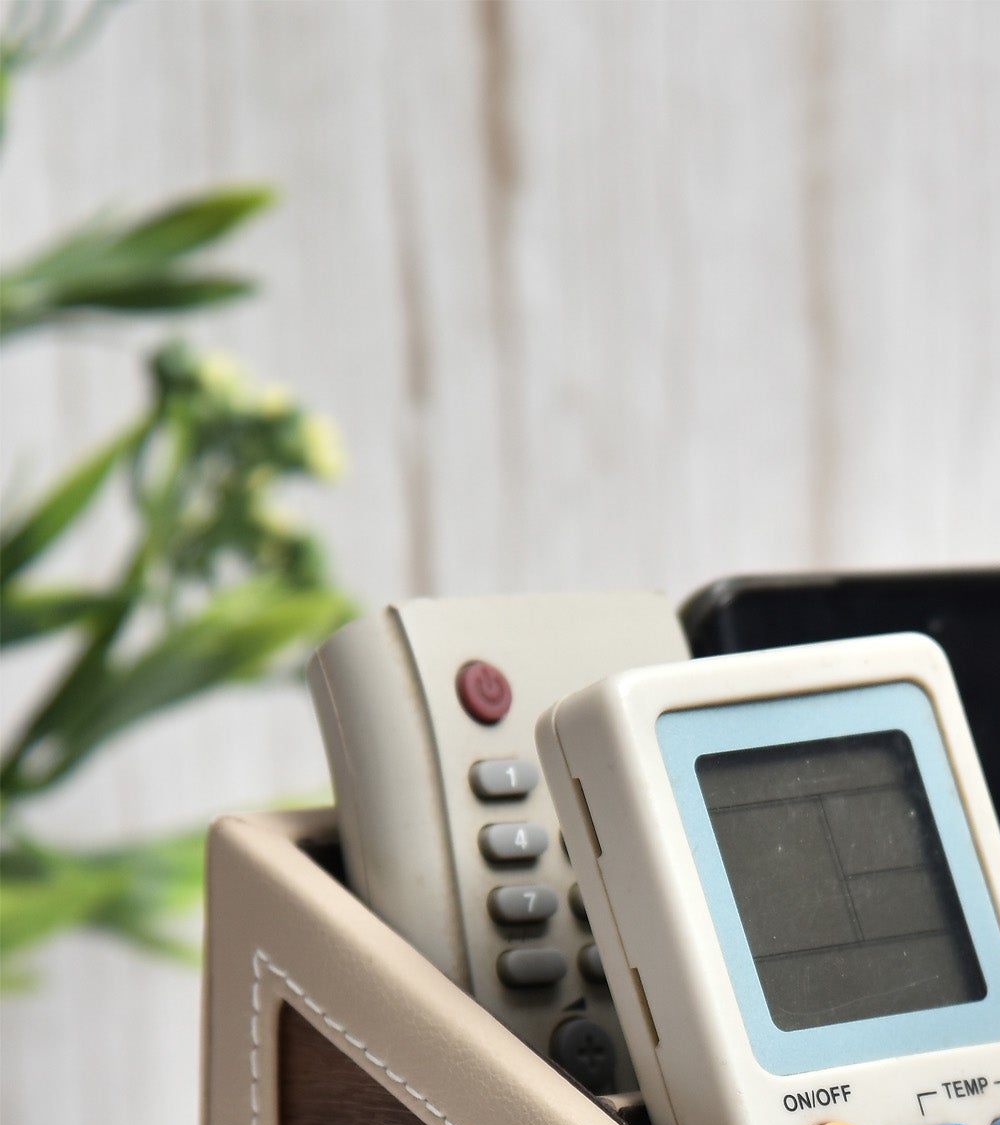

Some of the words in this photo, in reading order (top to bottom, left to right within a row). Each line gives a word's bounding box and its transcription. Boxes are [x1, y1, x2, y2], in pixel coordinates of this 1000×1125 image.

[505, 767, 516, 787] 1
[514, 829, 527, 849] 4
[523, 893, 536, 912] 7
[783, 1084, 851, 1112] ON/OFF
[941, 1077, 989, 1099] TEMP
